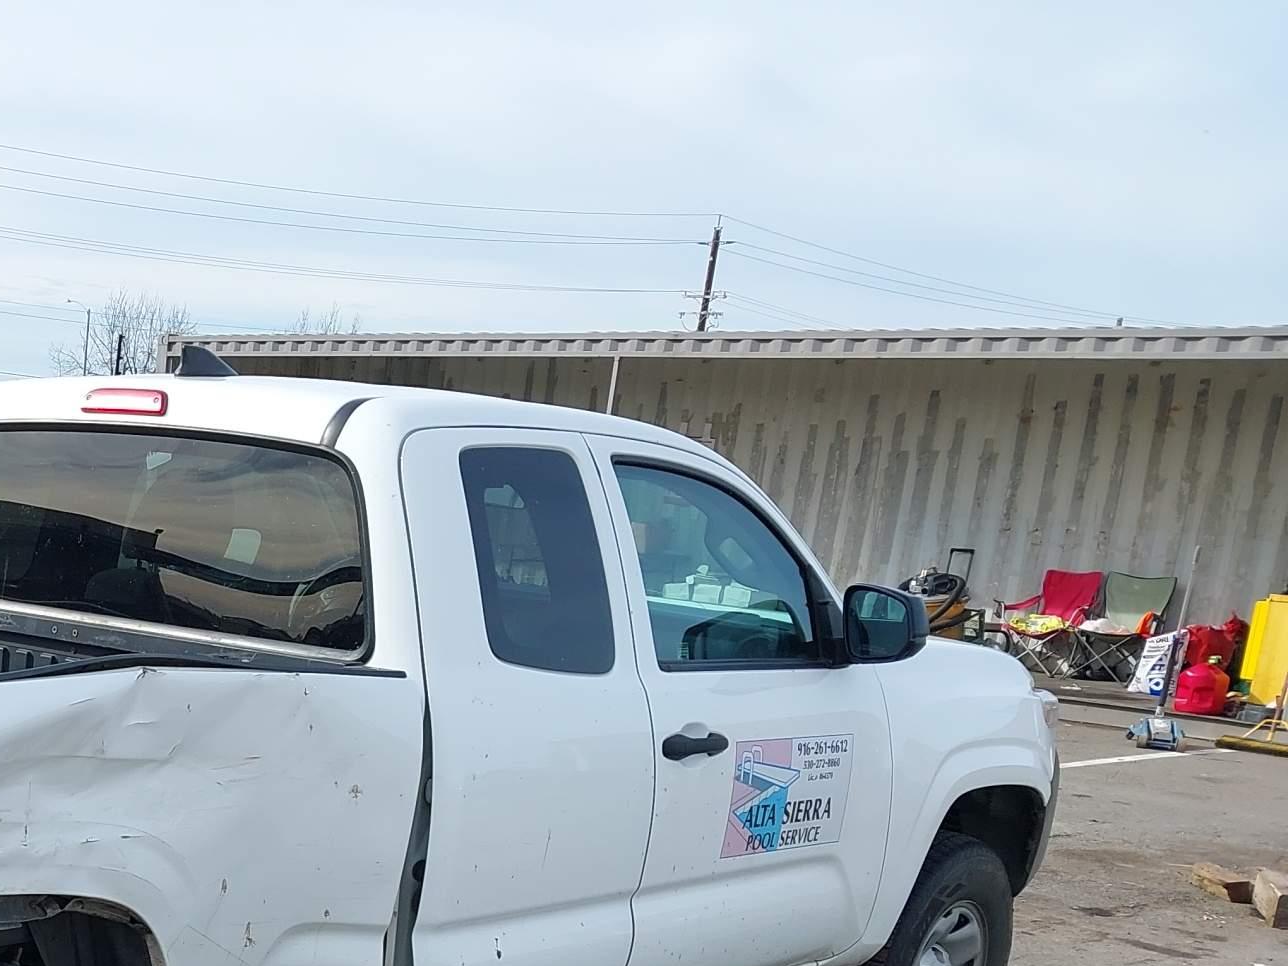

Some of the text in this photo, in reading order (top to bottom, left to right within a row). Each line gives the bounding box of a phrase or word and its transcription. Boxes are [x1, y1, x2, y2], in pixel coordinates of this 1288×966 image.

[797, 739, 848, 756] 916-261-6612
[742, 797, 832, 830] ALTA SIERRA
[745, 826, 822, 851] POOL SERVICE
